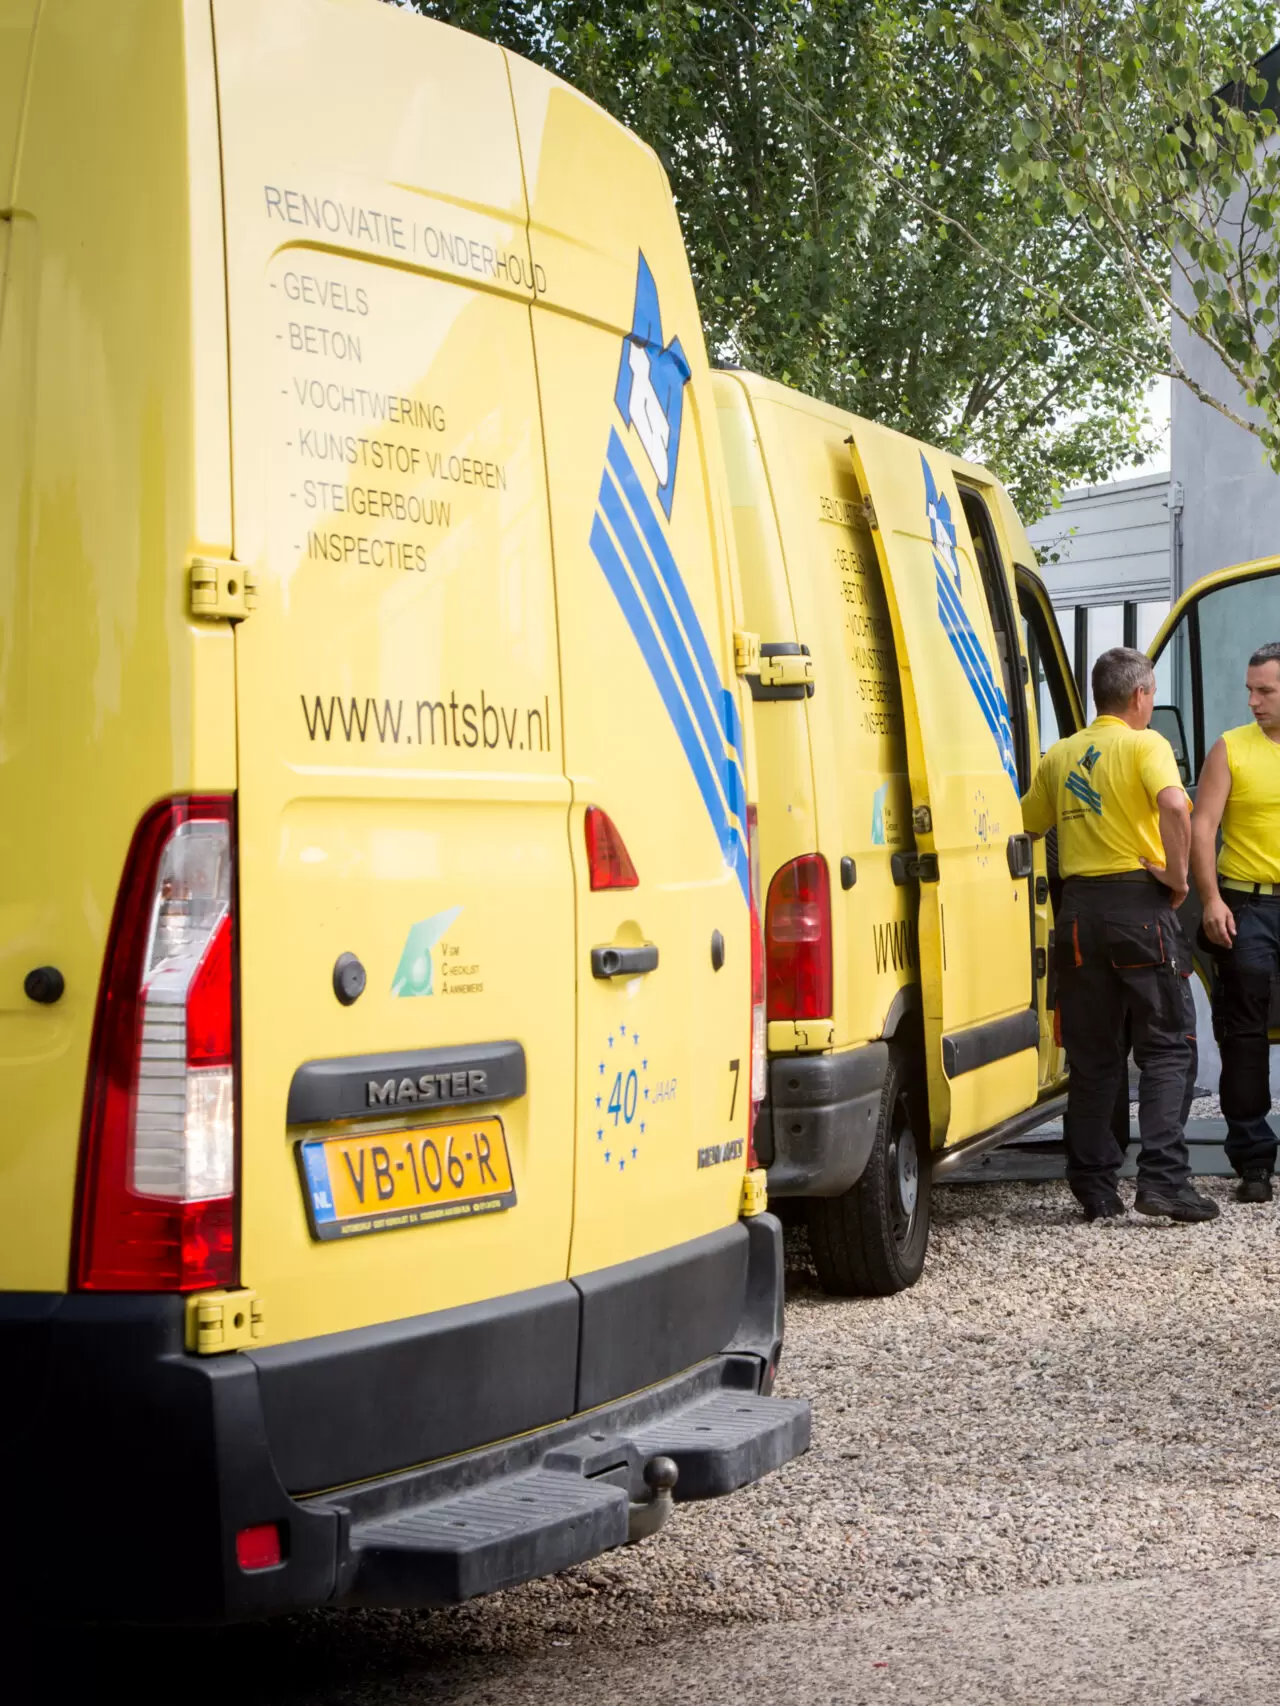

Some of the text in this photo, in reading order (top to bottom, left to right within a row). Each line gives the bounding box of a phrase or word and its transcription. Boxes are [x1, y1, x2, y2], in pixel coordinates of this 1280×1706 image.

[264, 186, 406, 250] RENOVATIE
[425, 227, 547, 293] ONDERHOUD
[284, 271, 369, 316] GEVELS
[289, 321, 362, 364] BETON
[293, 376, 447, 433] VOCHTWERING
[299, 427, 508, 491] KUNSTSTOF VLOEREN
[303, 479, 452, 528] STEIGERBOUW
[308, 530, 428, 573] INSPECTIES
[300, 690, 552, 752] www.mtsbv.nl
[365, 1069, 489, 1109] MASTER
[607, 1068, 678, 1128] 40 JAAR
[729, 1058, 740, 1122] 7
[342, 1131, 498, 1205] VB-106-R
[313, 1191, 332, 1210] NL
